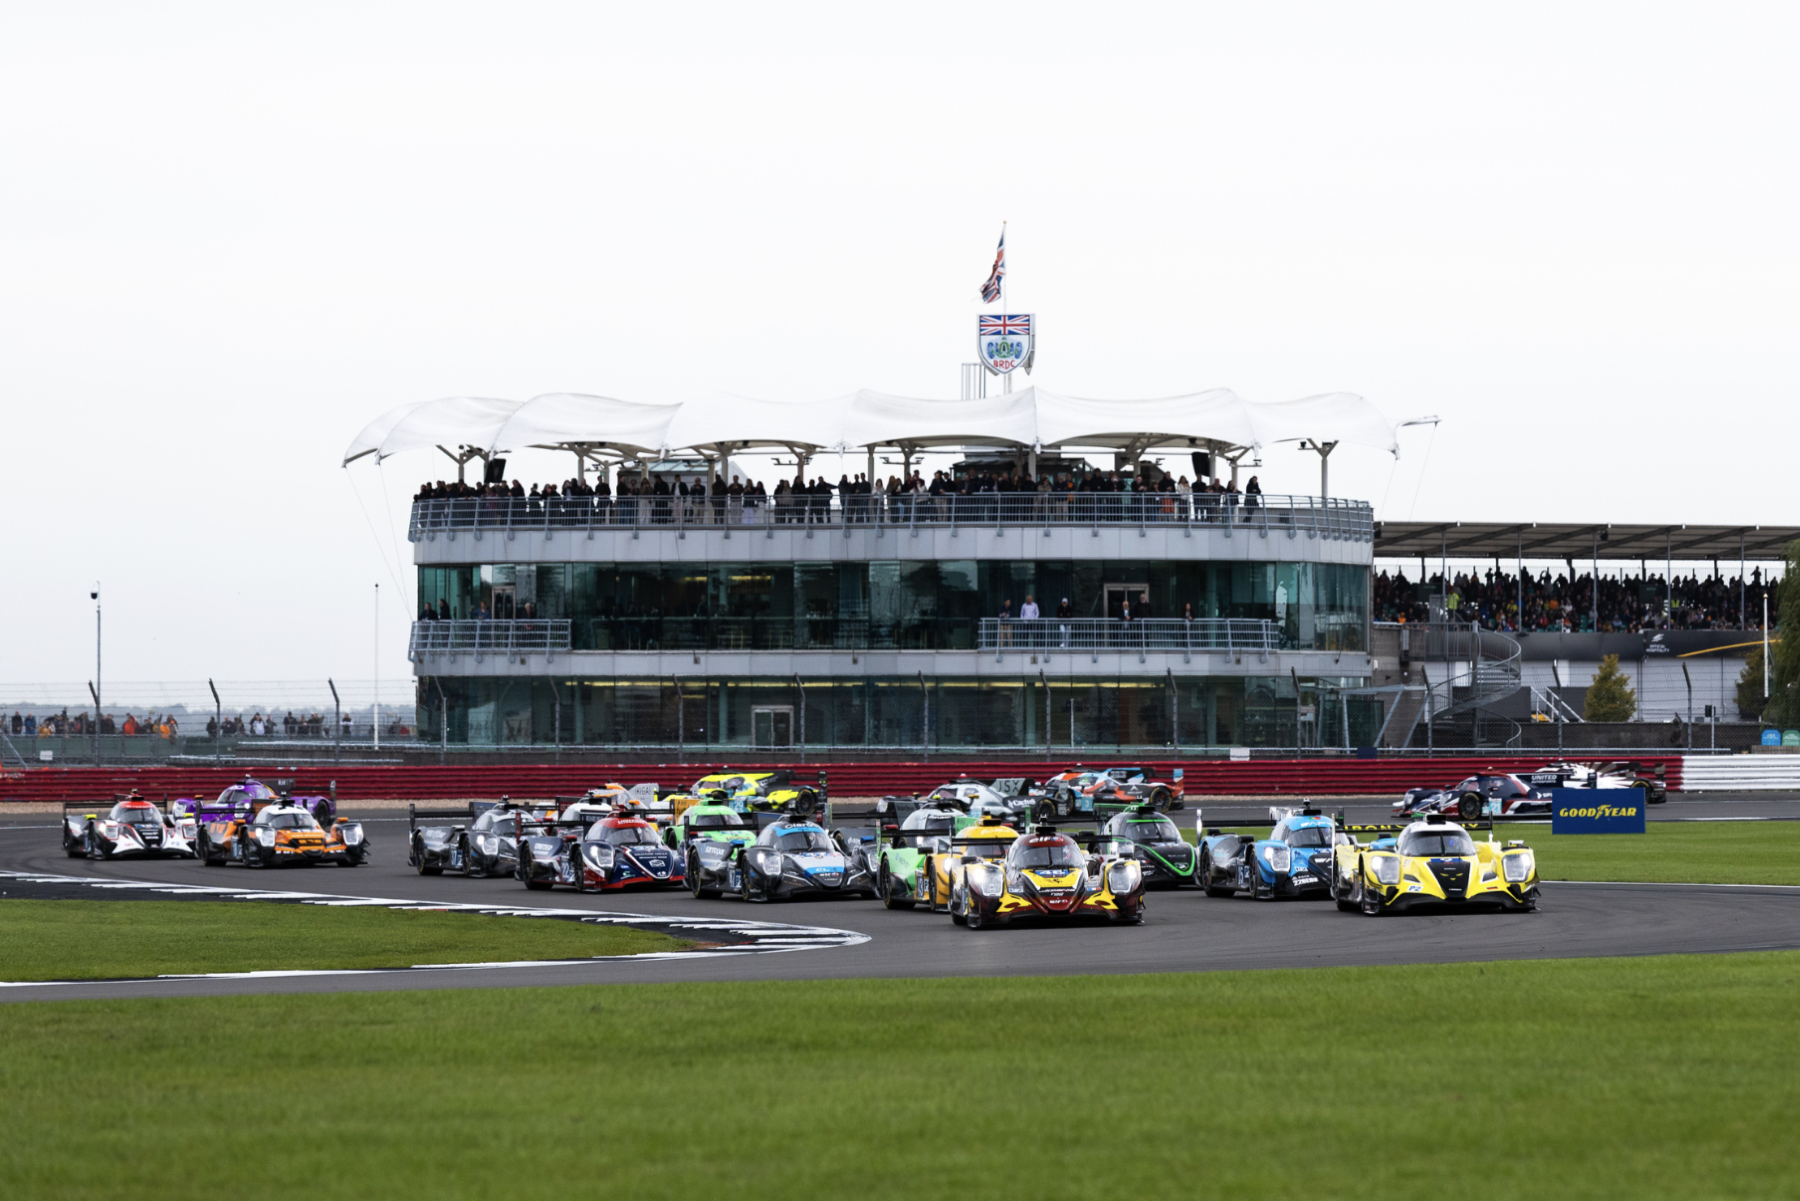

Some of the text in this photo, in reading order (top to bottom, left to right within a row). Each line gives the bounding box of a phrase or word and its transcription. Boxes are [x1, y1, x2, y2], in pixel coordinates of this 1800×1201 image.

[993, 359, 1015, 370] BRDC
[998, 780, 1021, 793] JSX
[1490, 802, 1501, 813] 21
[1559, 804, 1637, 820] GOODYEAR
